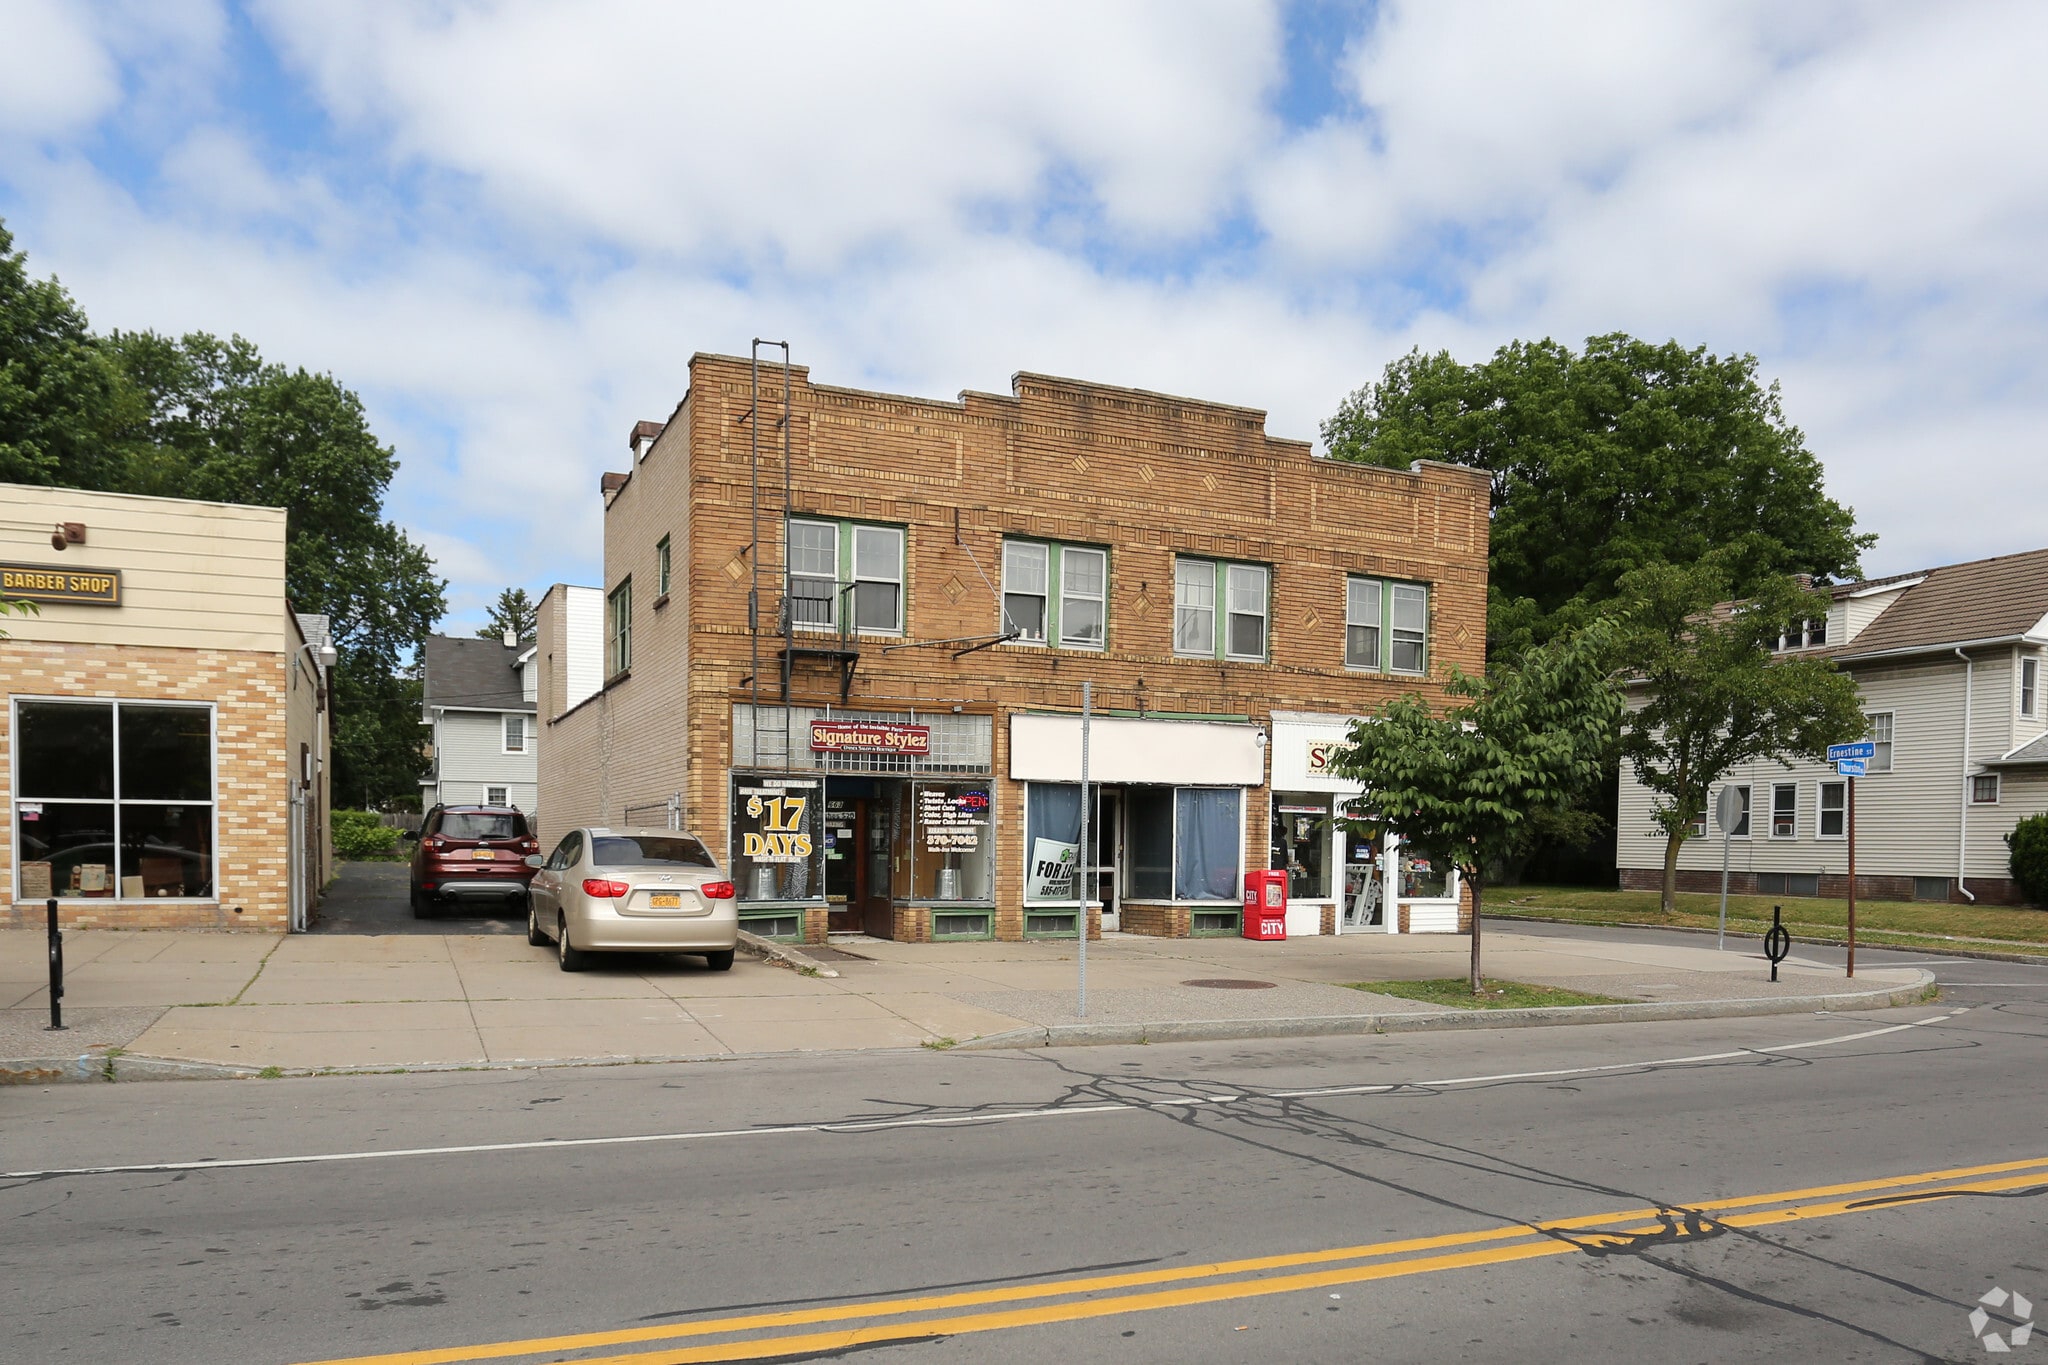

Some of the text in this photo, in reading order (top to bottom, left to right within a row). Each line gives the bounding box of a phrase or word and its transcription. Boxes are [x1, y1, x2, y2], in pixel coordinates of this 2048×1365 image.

[3, 572, 110, 593] BARBER SHOP
[813, 728, 927, 748] Signature Stylez
[1829, 747, 1864, 759] Ernestine
[743, 833, 813, 857] DAYS
[1036, 860, 1063, 879] FOR
[1246, 890, 1257, 900] CITY
[1261, 922, 1284, 935] CITY
